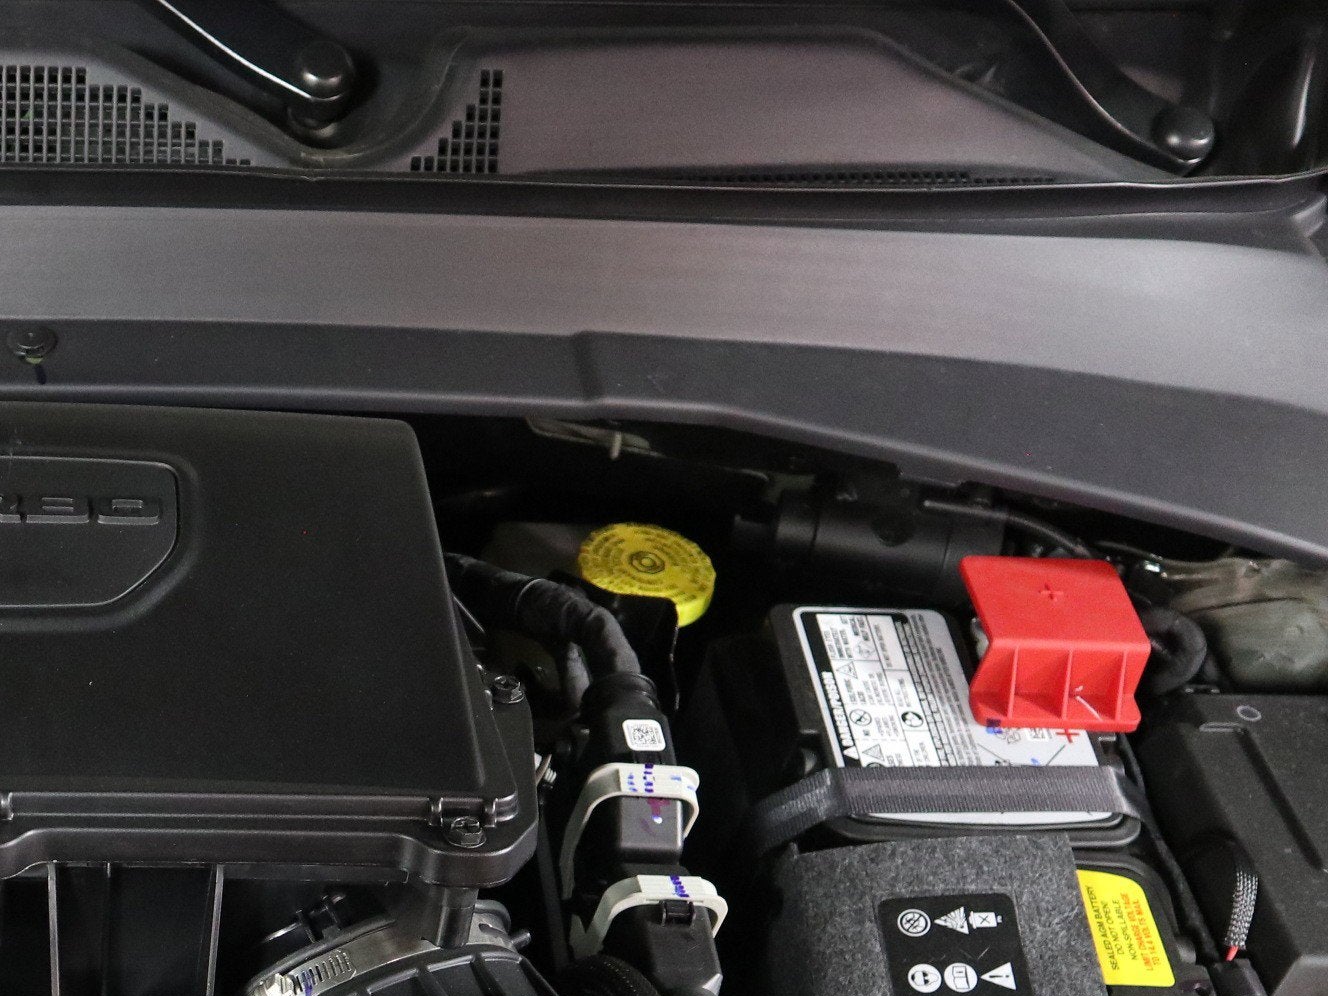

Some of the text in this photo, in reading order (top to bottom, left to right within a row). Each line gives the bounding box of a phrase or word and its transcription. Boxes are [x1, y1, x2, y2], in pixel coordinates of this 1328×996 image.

[1086, 886, 1120, 971] SEALED AGM BATTERY
[1108, 926, 1119, 943] NOT
[1114, 944, 1124, 955] DO
